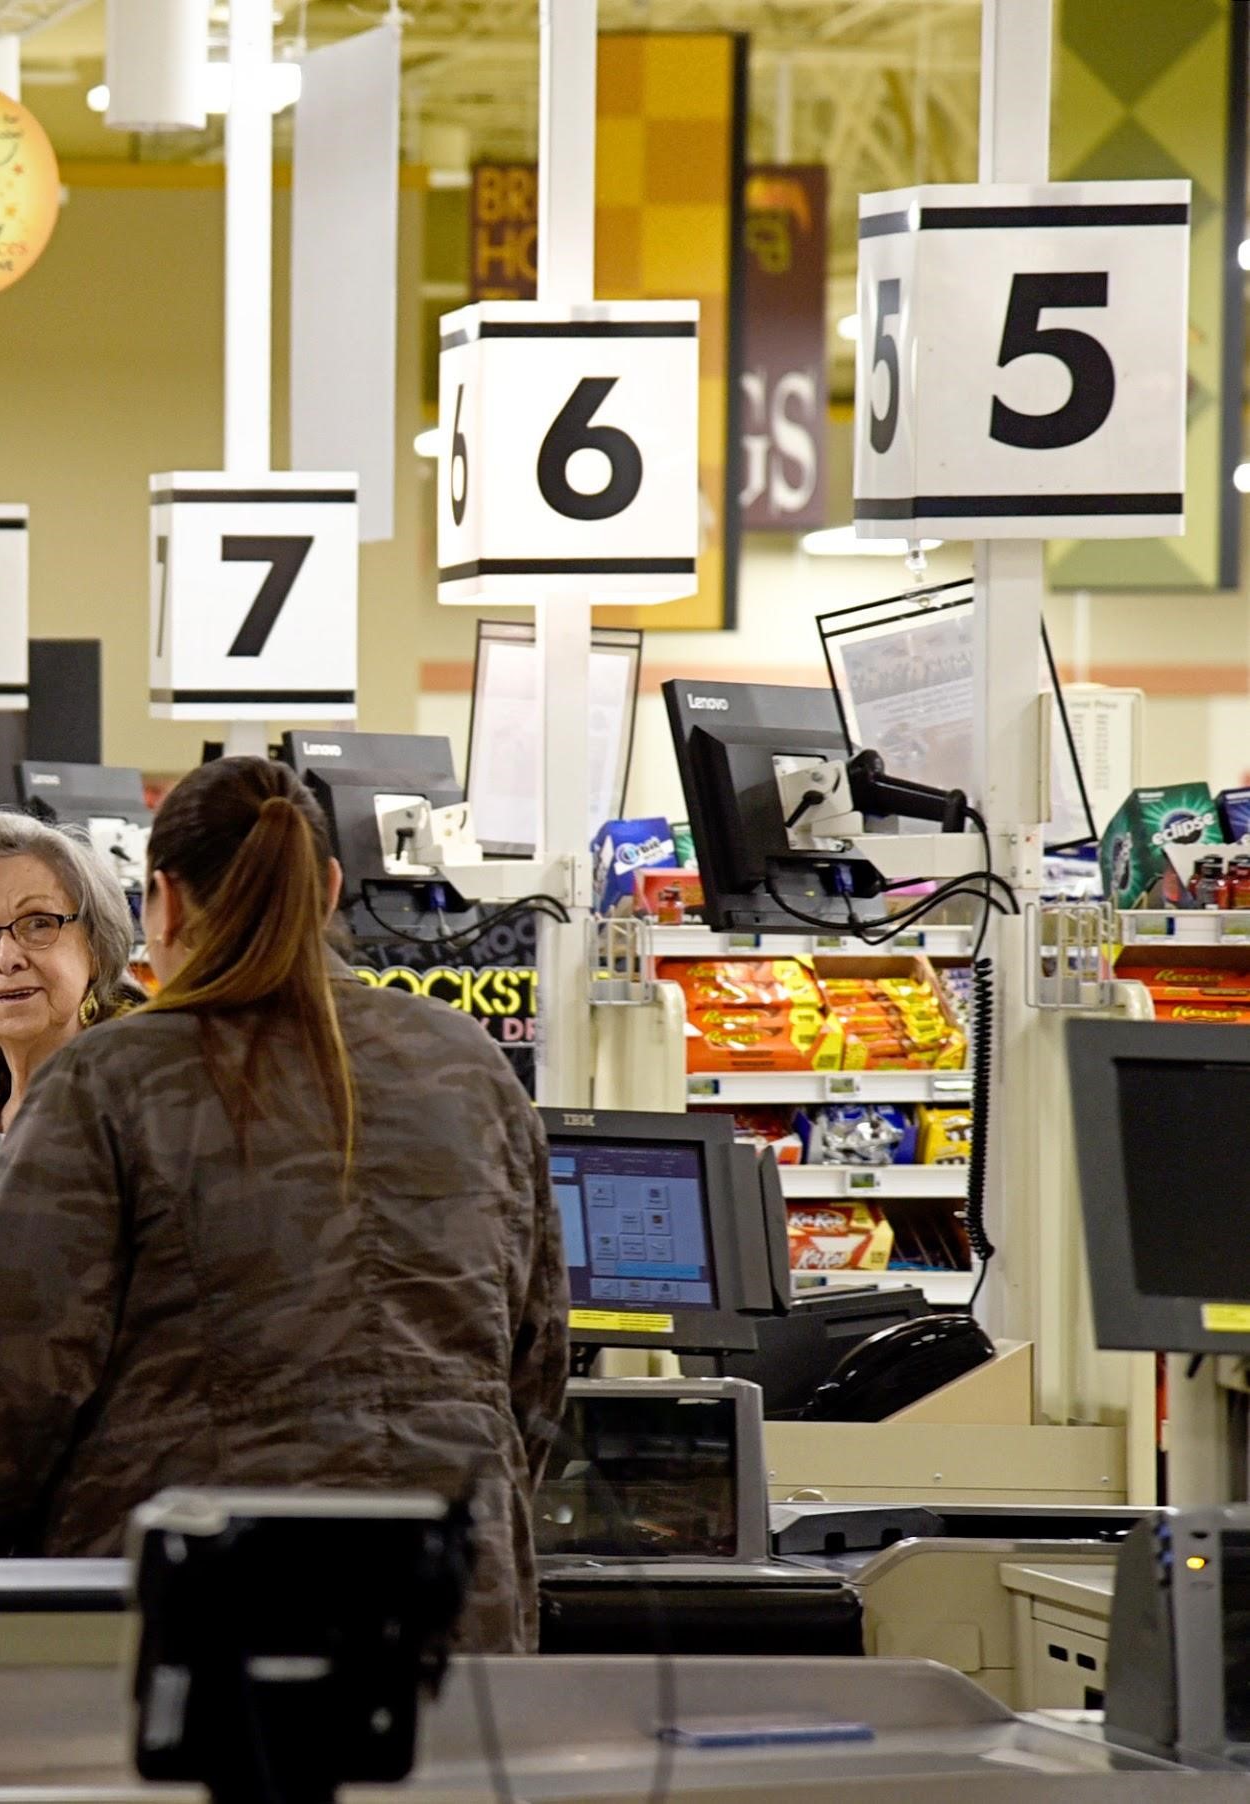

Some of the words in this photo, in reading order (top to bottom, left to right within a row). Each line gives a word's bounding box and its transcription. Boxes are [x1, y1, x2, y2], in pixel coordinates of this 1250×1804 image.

[870, 278, 901, 455] 5
[989, 271, 1116, 450] 5
[451, 383, 468, 527] 6
[537, 376, 644, 521] 6
[221, 535, 315, 658] 7
[302, 741, 343, 757] Lenovo
[686, 693, 729, 711] Lenovo
[1152, 812, 1215, 846] eclipse
[563, 1114, 595, 1127] IBM
